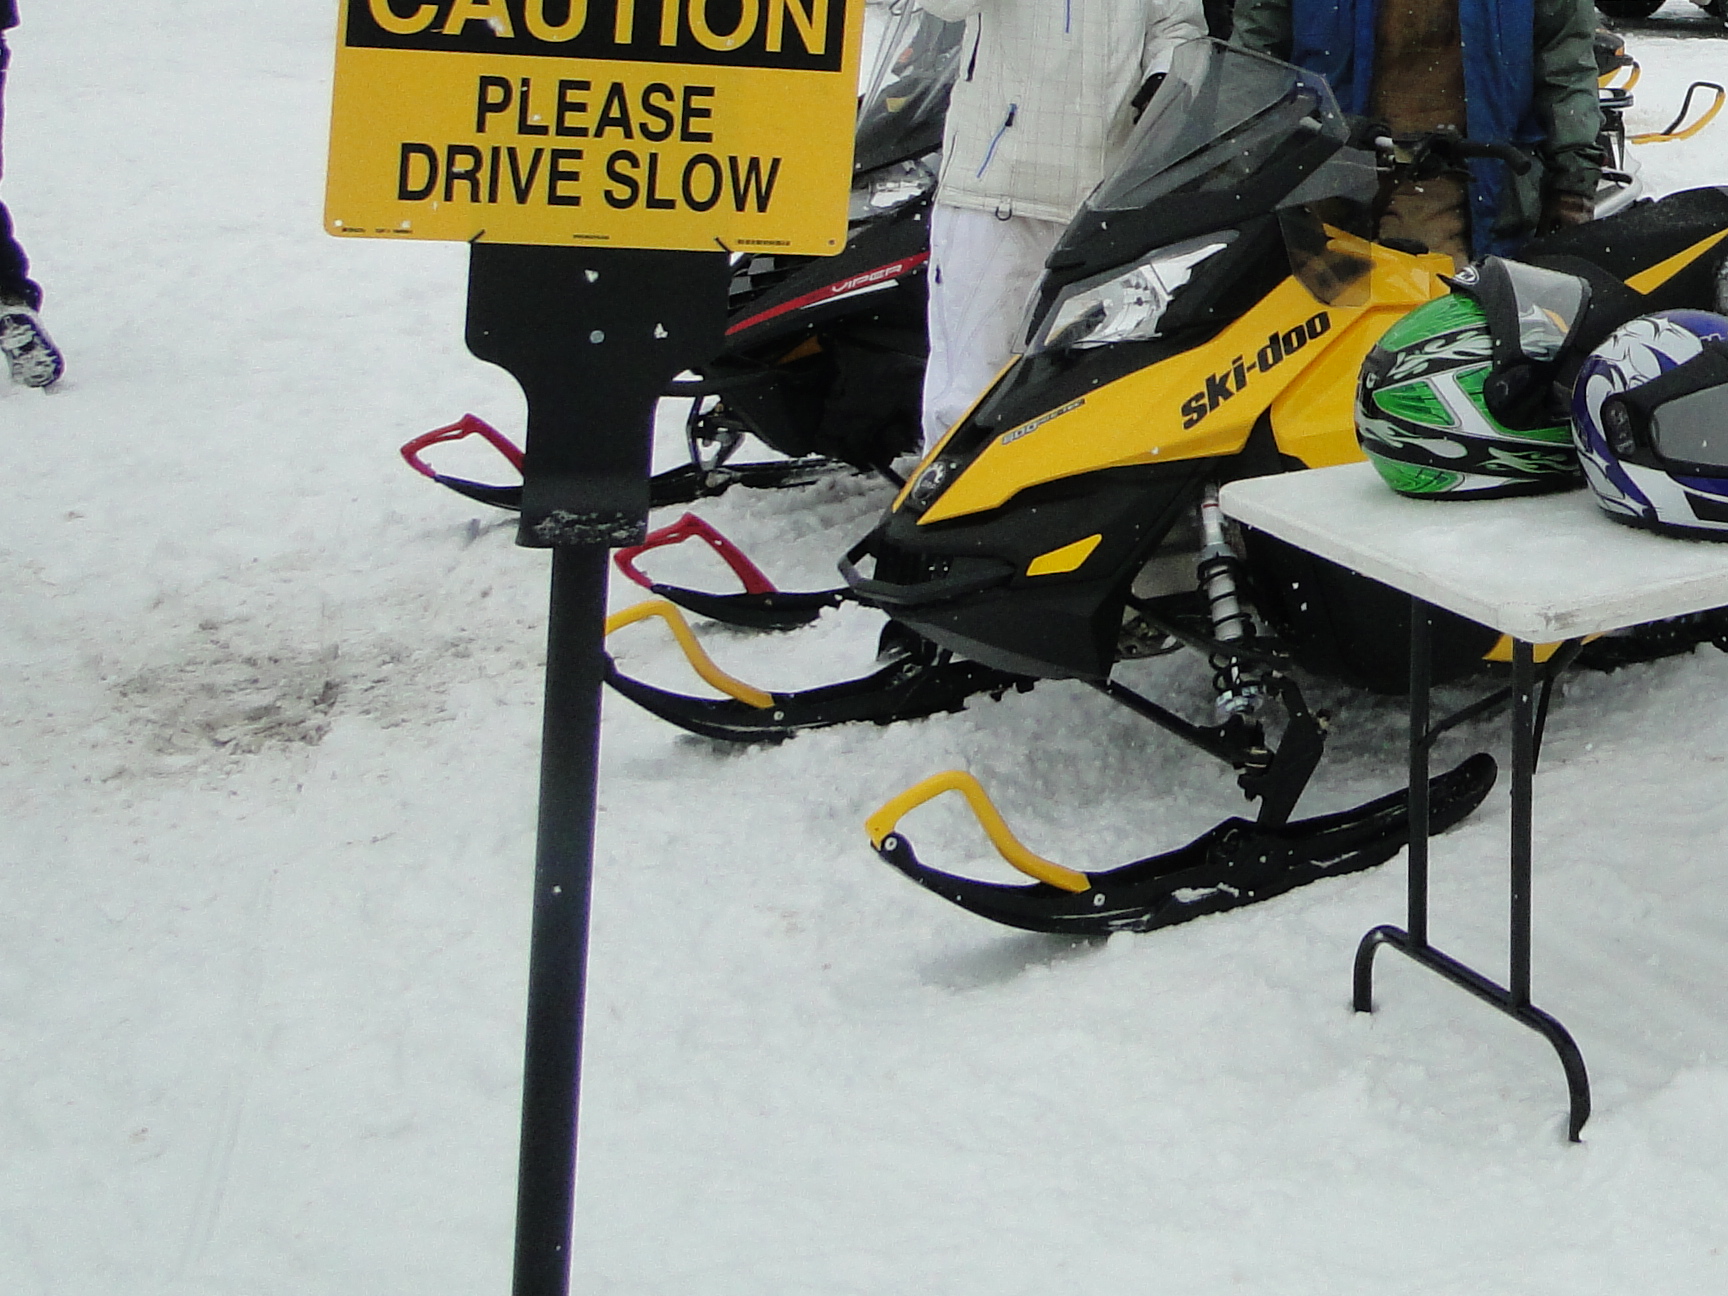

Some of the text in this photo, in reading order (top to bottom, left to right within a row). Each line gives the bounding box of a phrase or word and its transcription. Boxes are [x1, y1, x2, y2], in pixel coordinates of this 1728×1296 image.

[475, 75, 716, 143] PLEASE
[397, 142, 782, 214] DRIVE SLOW
[831, 264, 903, 293] VIPER
[1179, 310, 1332, 431] ski-doo
